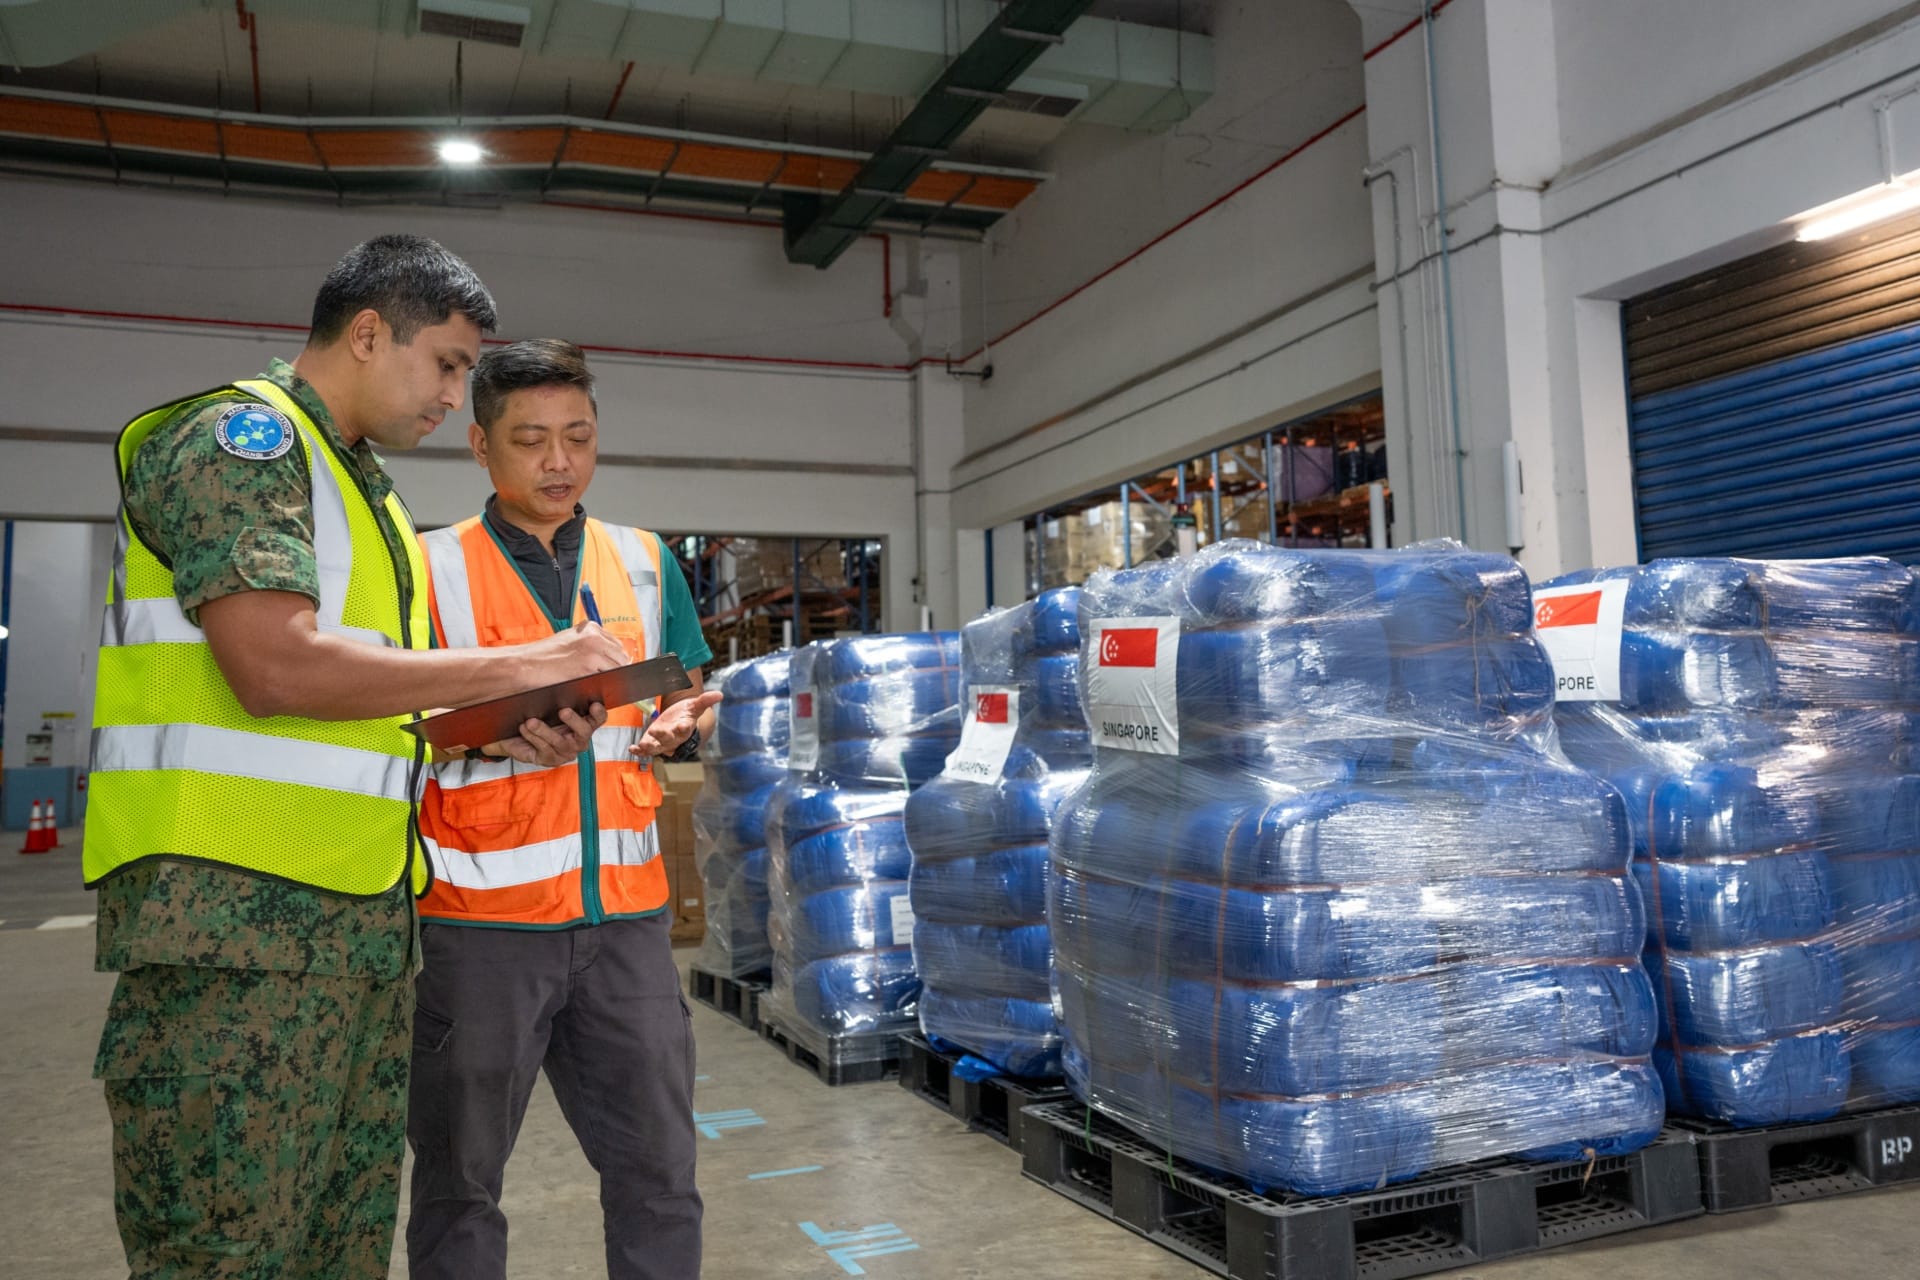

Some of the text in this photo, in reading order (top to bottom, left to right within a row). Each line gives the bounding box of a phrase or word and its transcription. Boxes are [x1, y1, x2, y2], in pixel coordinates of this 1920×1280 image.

[602, 615, 637, 625] gistics
[1557, 676, 1595, 690] PORE
[1103, 721, 1159, 742] SINGAPORE
[1881, 1136, 1912, 1165] BP
